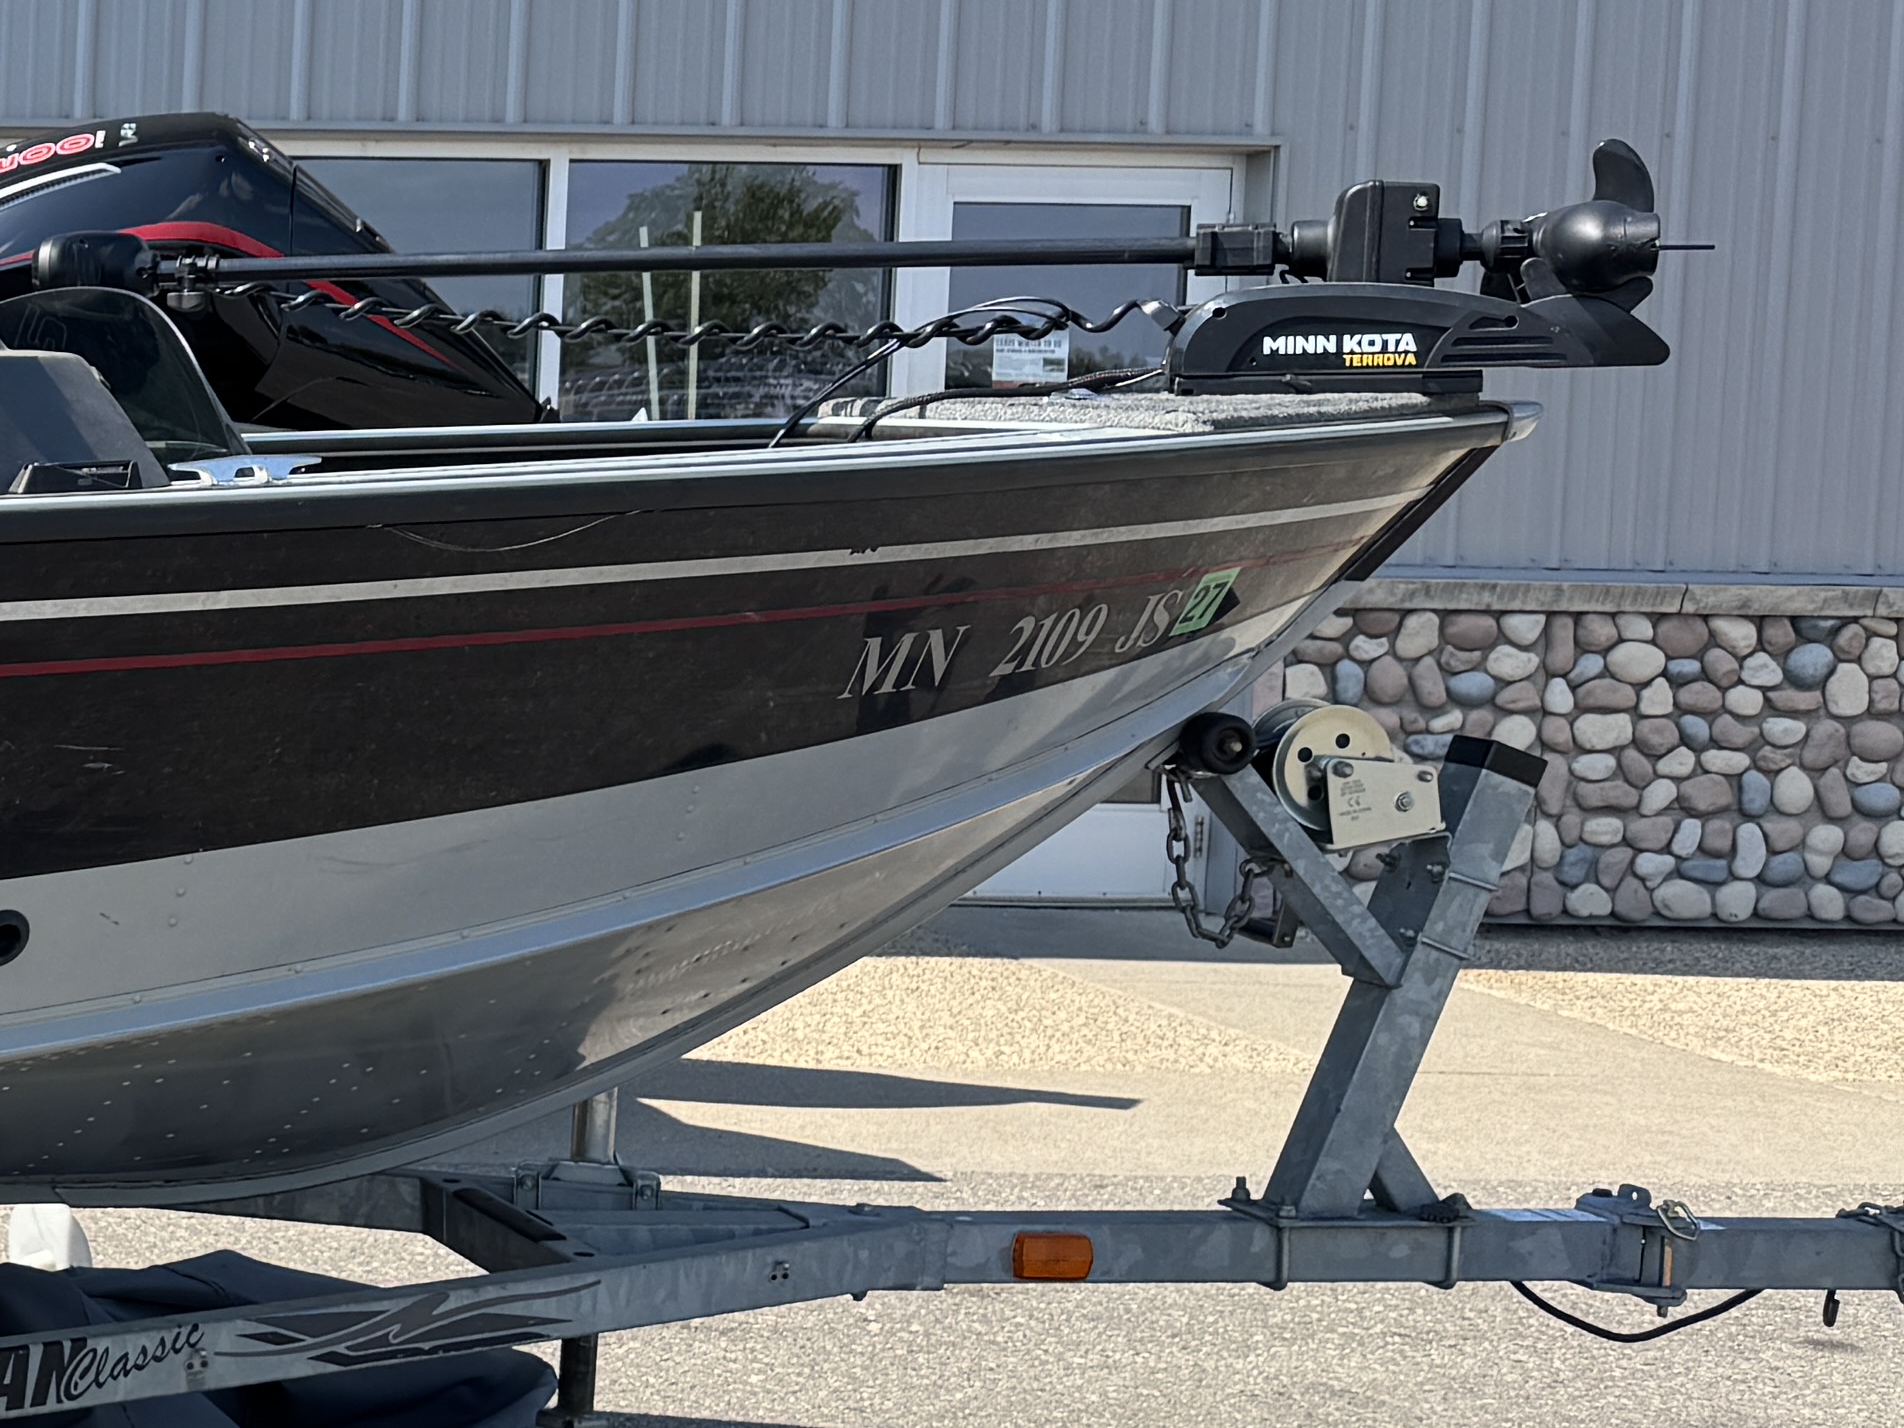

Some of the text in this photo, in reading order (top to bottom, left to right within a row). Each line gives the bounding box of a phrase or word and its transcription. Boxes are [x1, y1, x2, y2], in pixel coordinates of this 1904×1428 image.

[1262, 332, 1418, 355] MINN KOTA
[1342, 353, 1417, 367] TERROVA
[1182, 581, 1228, 625] 27
[836, 590, 1184, 700] MN 2109 JS
[63, 1322, 205, 1404] Classic
